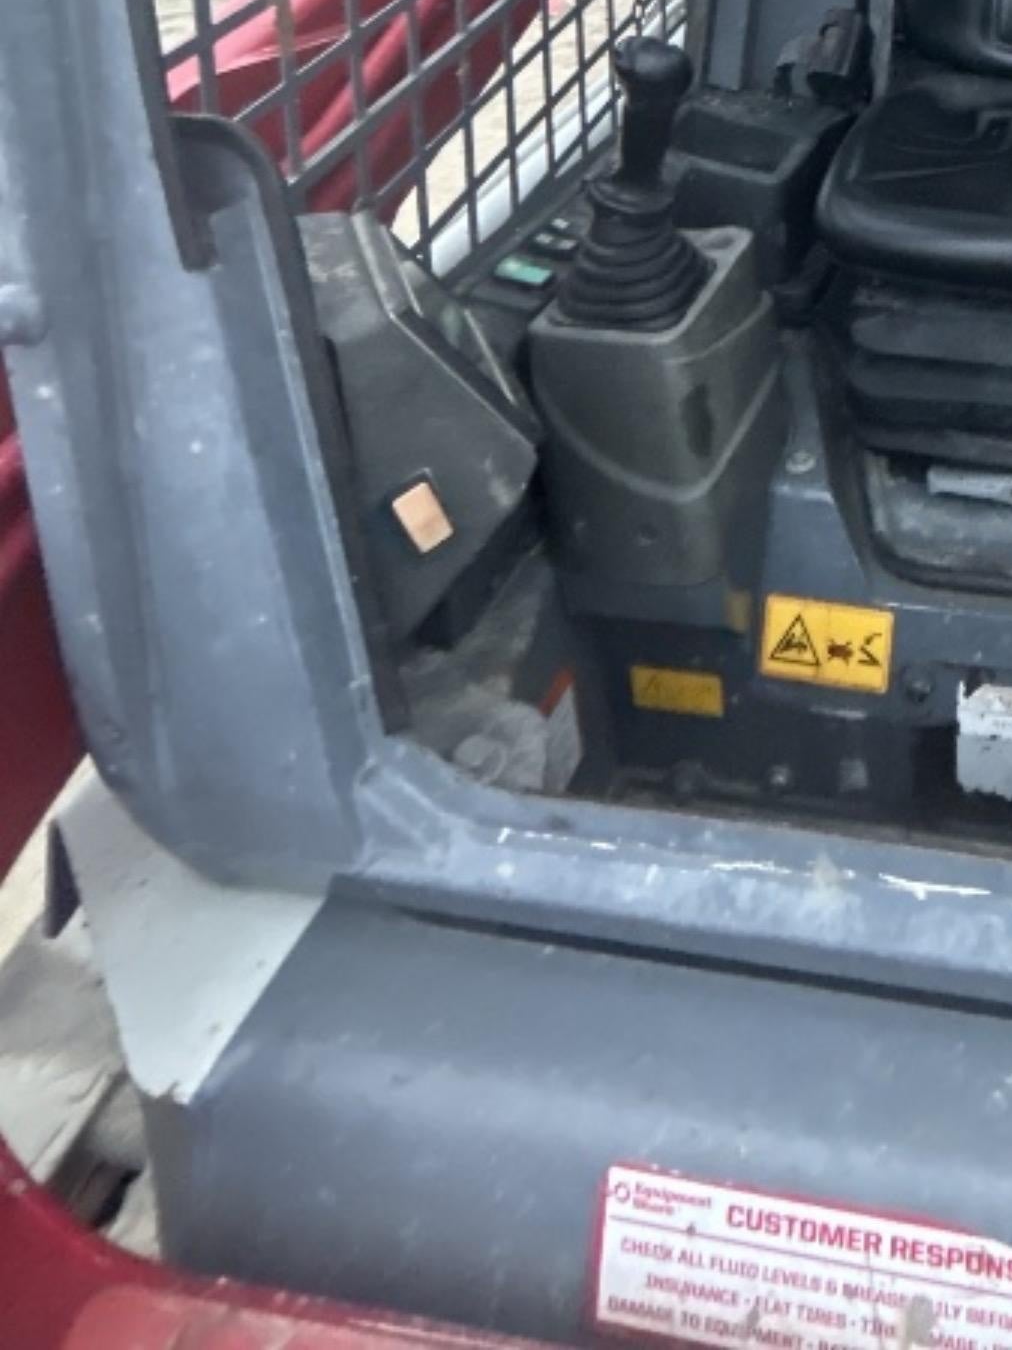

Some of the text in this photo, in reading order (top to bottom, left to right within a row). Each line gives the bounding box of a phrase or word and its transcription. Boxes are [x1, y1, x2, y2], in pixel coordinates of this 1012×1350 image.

[727, 1204, 883, 1256] CUSTOMER
[620, 1236, 675, 1262] CHECK
[677, 1249, 704, 1269] ALL
[709, 1254, 760, 1281] FLUID
[762, 1263, 823, 1293] LEVELS
